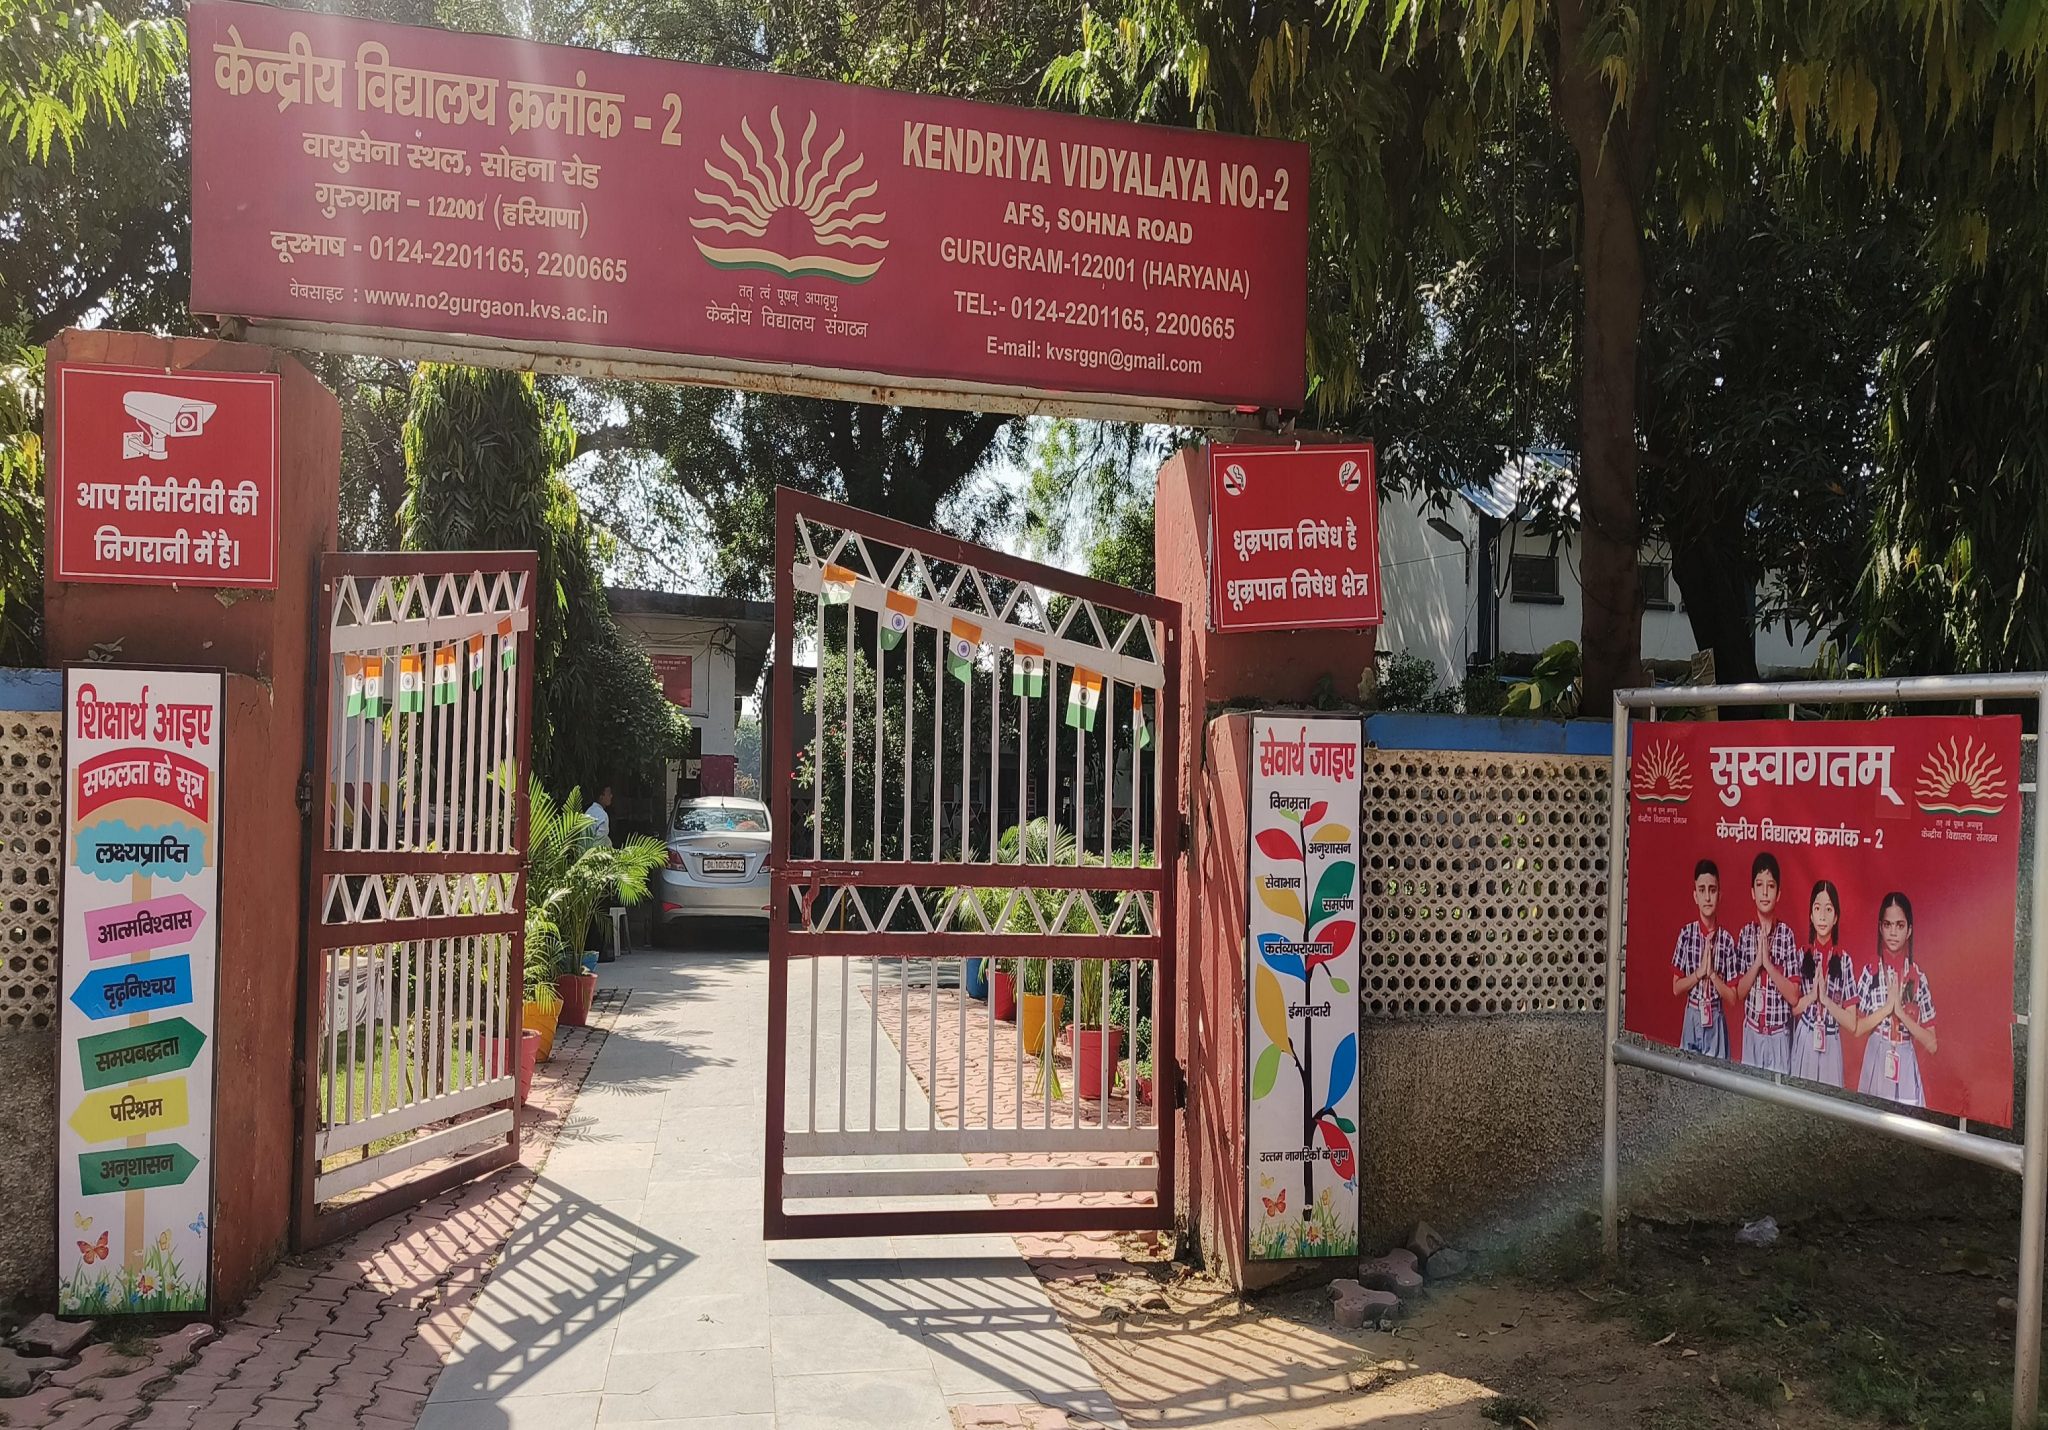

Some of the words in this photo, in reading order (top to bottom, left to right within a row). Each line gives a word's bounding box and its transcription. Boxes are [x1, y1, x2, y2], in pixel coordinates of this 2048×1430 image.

[213, 25, 345, 113] केन्द्रीय
[355, 40, 498, 125] विद्यालय
[508, 70, 625, 139] क्रमांक
[661, 93, 682, 146] 2
[303, 130, 401, 174] वायुसेना
[480, 145, 556, 183] सोहना
[562, 154, 601, 190] रोड
[904, 121, 1052, 184] KENDRIYA
[1061, 142, 1210, 203] VIDYALAYA
[1219, 161, 1290, 212] NO.-2
[315, 183, 401, 219] गुरुग्राम
[428, 195, 487, 221] 122001
[493, 194, 588, 239] (हरियाणा)
[1004, 201, 1052, 235] AFS,
[1058, 207, 1131, 238] SOHNA
[1137, 218, 1193, 245] ROAD
[270, 231, 346, 264] दूरभाष
[369, 236, 529, 278] 0124-2201165,
[537, 252, 628, 283] 2200665
[940, 237, 1136, 284] GURUGRAM-122001
[1142, 263, 1250, 299] (HARYANA)
[289, 278, 344, 303] वेबसाइट
[365, 286, 609, 325] www.no2gurgaon.kvs.ac.in
[739, 284, 754, 302] तत्
[760, 284, 771, 300] त्वं
[777, 288, 799, 307] पूषन्
[805, 292, 838, 312] अपावृणु
[953, 290, 1006, 317] TEL:-
[1011, 294, 1150, 337] 0124-2201165,
[1156, 311, 1235, 340] 2200665
[705, 300, 752, 325] केन्द्रीय
[761, 305, 816, 332] विद्यालय
[825, 314, 868, 338] संगठन
[986, 335, 1042, 361] E-mail:
[1046, 341, 1202, 375] kvsrggn@gmail.com
[77, 482, 121, 510] आप
[124, 475, 225, 515] सीसीटीवी
[228, 480, 259, 516] की
[94, 525, 190, 564] निगरानी
[193, 529, 216, 565] में
[1233, 528, 1293, 562] धूम्रपान
[1297, 518, 1342, 550] निषेध
[1346, 516, 1357, 550] है
[1227, 577, 1287, 612] धूम्रपान
[1291, 568, 1336, 599] निषेध
[1341, 567, 1368, 598] क्षेत्र
[76, 682, 148, 740] शिक्षार्थ
[153, 703, 213, 749] आइए
[1259, 726, 1306, 778] सेवार्थ
[1308, 742, 1357, 783] जाइए
[83, 760, 150, 797] सफलता
[153, 753, 173, 787] के
[176, 766, 205, 809] सूत्र
[1709, 745, 1905, 806] सुस्वागतम्
[1270, 790, 1311, 812] विनम्रता
[95, 835, 190, 867] लक्ष्यप्राप्ति
[1307, 842, 1351, 860] अनुशासन
[1715, 816, 1758, 844] केन्द्रीय
[1761, 817, 1811, 846] विद्यालय
[1814, 823, 1859, 848] क्रमांक
[1875, 831, 1883, 849] 2
[1265, 873, 1301, 889] सेवाभाव
[1322, 894, 1354, 912] समर्पण
[97, 908, 193, 945] आत्मविश्वास
[1265, 938, 1333, 955] कर्तव्यपरायणता
[102, 974, 176, 1010] दृढ़निश्चय
[1288, 1001, 1331, 1018] ईमानदारी
[95, 1036, 180, 1073] समयबद्धता
[110, 1095, 163, 1122] परिश्रम
[100, 1153, 174, 1187] अनुशासन
[1259, 1150, 1283, 1163] उत्तम
[1285, 1146, 1320, 1163] नागरिकों
[1322, 1148, 1331, 1162] के
[1332, 1149, 1349, 1168] गुण
